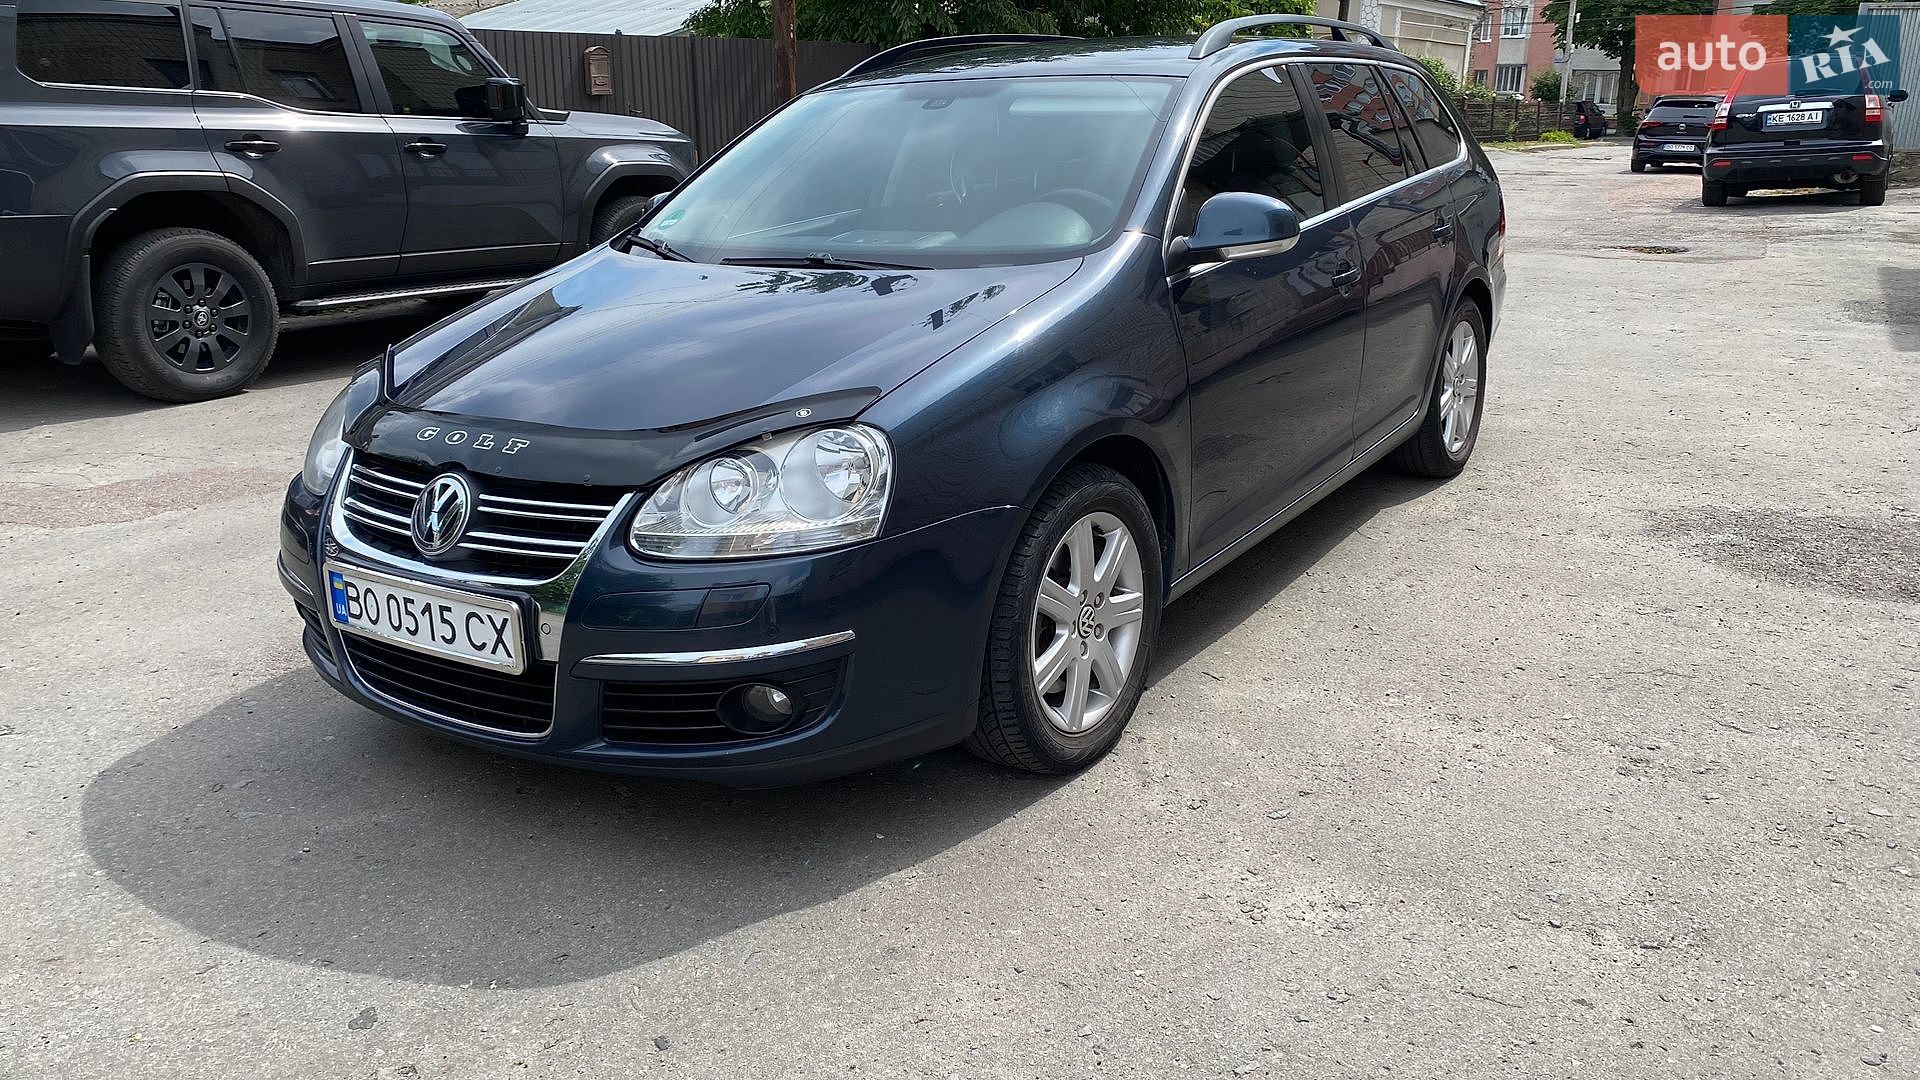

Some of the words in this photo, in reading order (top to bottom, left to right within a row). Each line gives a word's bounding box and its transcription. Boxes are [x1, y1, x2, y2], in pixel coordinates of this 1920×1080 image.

[1772, 115, 1784, 123] KE
[1787, 113, 1805, 122] 1628
[1807, 112, 1818, 121] AI
[417, 427, 530, 454] GOLF
[336, 602, 347, 616] UA
[345, 580, 380, 626] BO
[386, 593, 457, 645] 0515
[465, 611, 513, 659] CX
